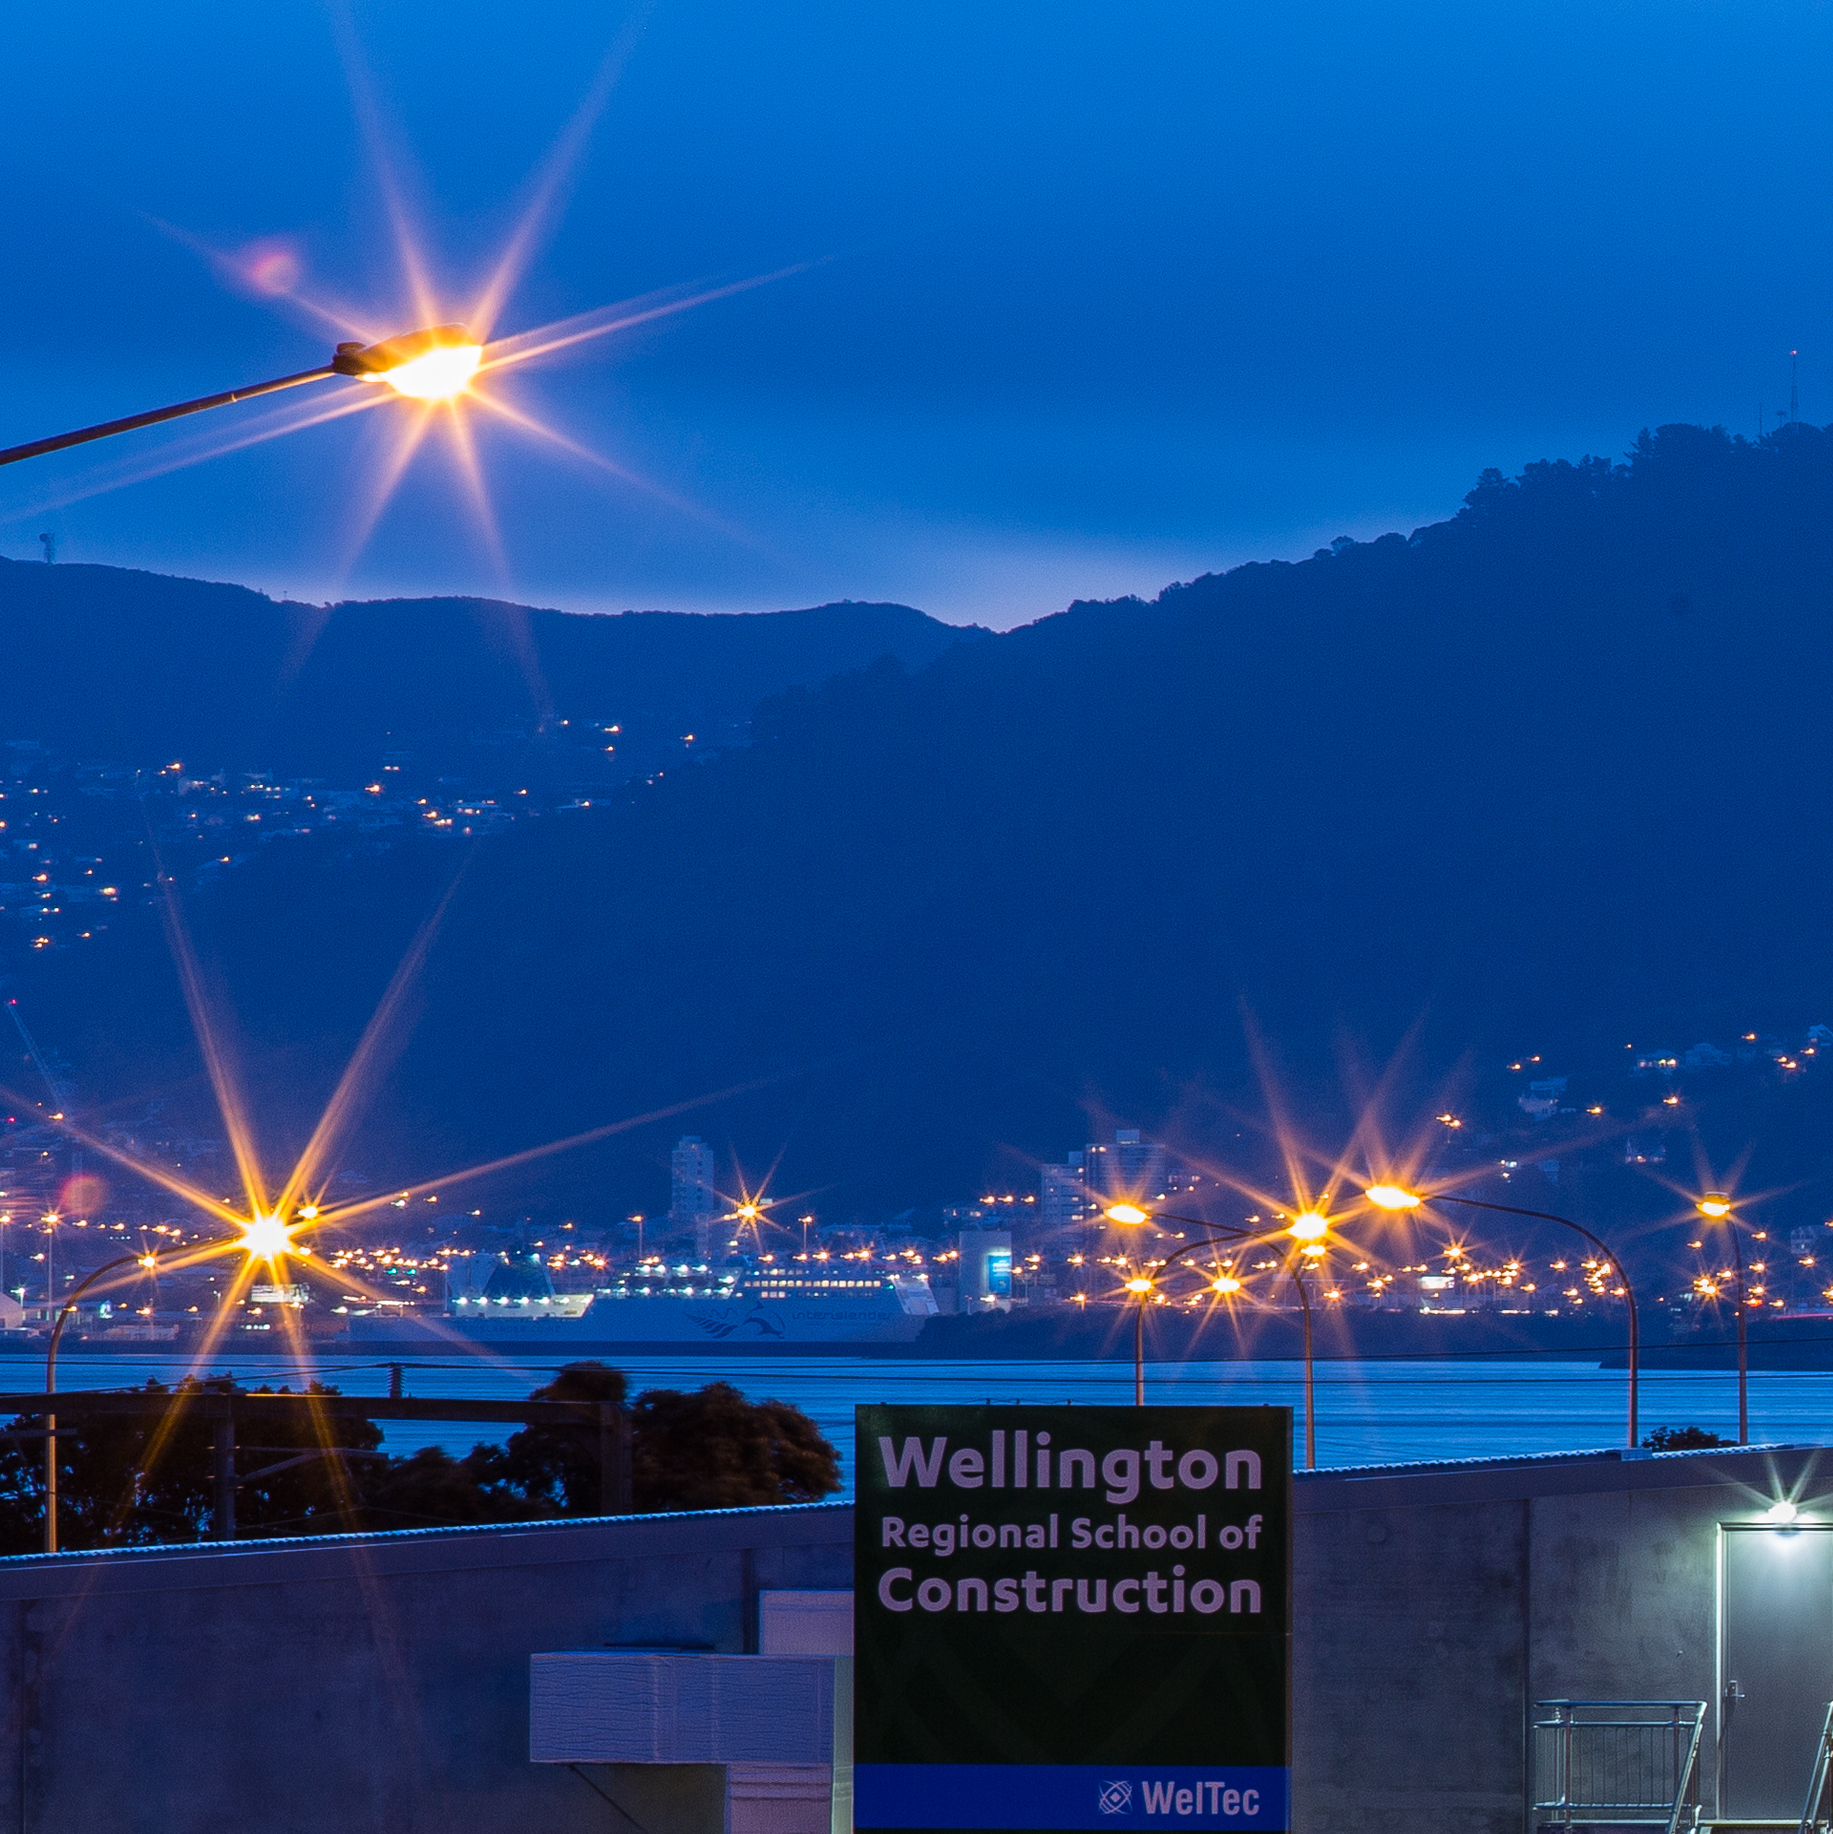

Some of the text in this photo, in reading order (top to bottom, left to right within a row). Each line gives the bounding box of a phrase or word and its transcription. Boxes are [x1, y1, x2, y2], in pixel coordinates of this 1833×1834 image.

[878, 1429, 1262, 1504] Wellington
[881, 1513, 1262, 1557] Regional School of
[877, 1564, 1262, 1614] Construction
[1142, 1780, 1261, 1816] WelTec
